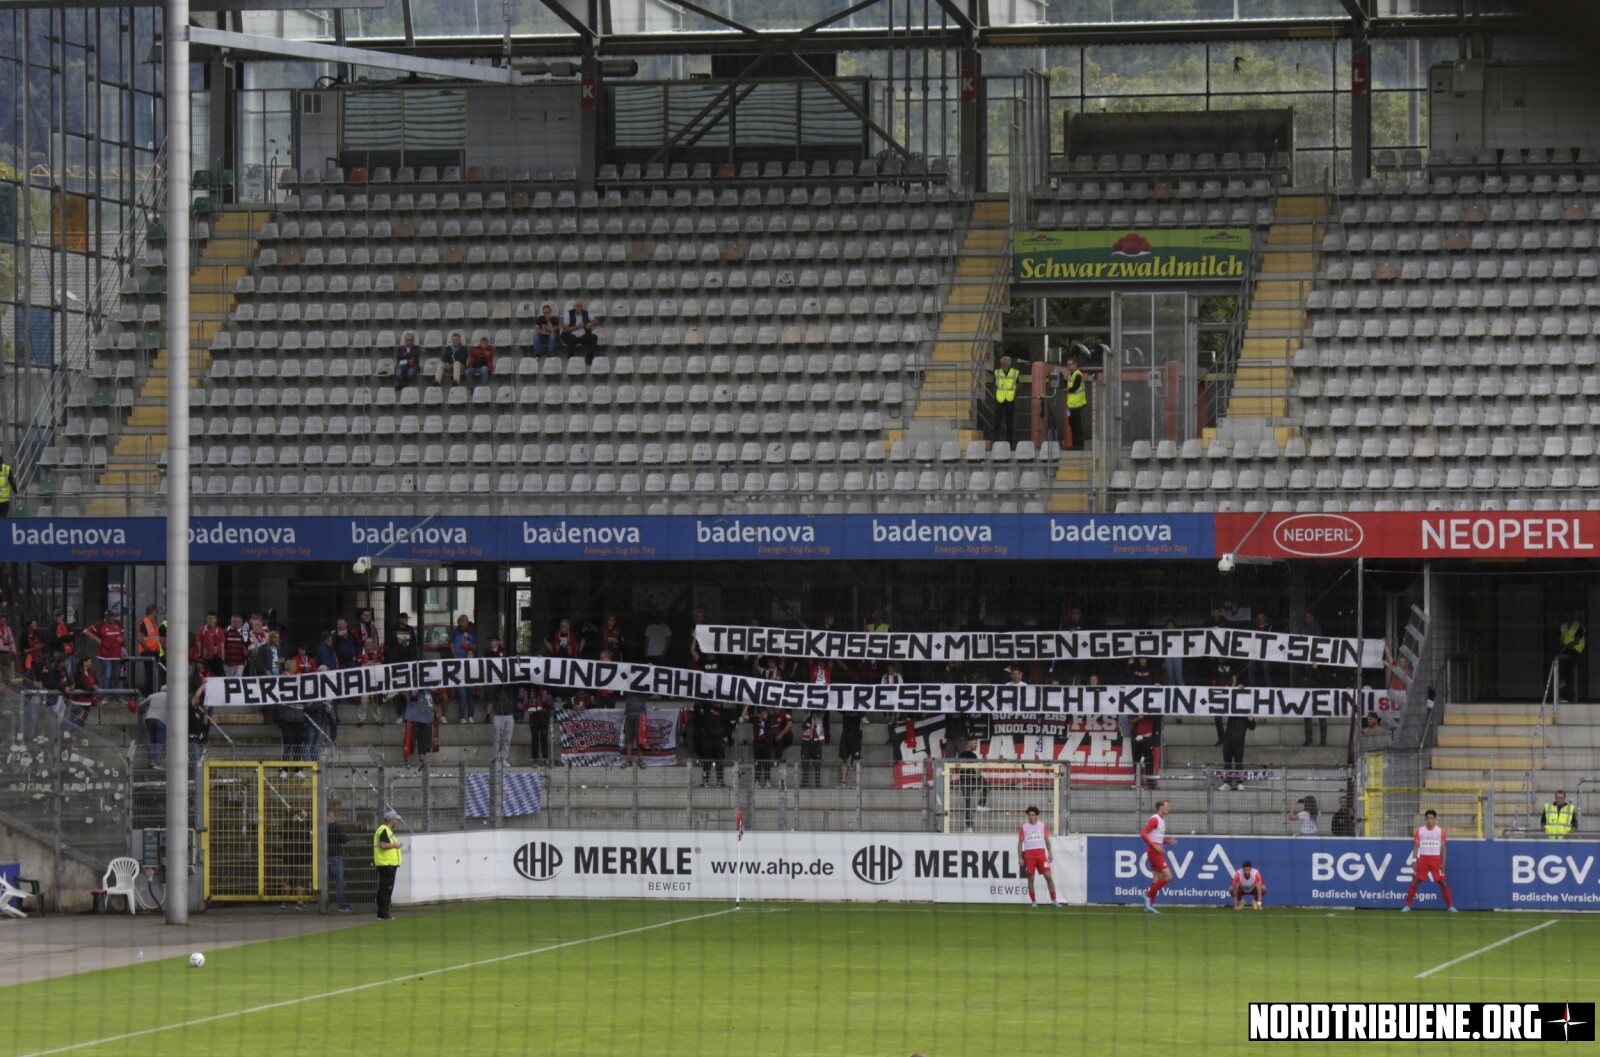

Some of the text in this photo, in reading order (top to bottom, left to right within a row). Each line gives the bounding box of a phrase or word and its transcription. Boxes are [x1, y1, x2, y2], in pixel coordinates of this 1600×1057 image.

[963, 78, 974, 91] K
[1354, 69, 1364, 82] L
[583, 85, 594, 98] K
[1020, 254, 1245, 278] Schwarzwaldmilch
[12, 523, 126, 545] badenova
[351, 521, 467, 544] badenova
[522, 521, 640, 543] badenova
[696, 520, 815, 542] badenova
[872, 520, 992, 542] badenova
[1050, 518, 1172, 542] badenova
[1421, 518, 1594, 550] NEOPERL
[443, 547, 455, 556] Tag
[470, 547, 482, 556] Tag
[616, 547, 628, 556] Tag
[643, 547, 656, 556] Tag
[790, 546, 803, 555] Tag
[818, 546, 830, 555] Tag
[967, 545, 979, 555] Tag
[994, 545, 1007, 555] Tag
[1146, 544, 1159, 554] Tag
[1174, 544, 1187, 554] Tag
[708, 626, 1364, 664] TAGESKASSEN MÜSSEN GEÖFFNET SEIN
[224, 658, 531, 704] PERSONALISIERUNG
[543, 658, 618, 687] UND
[629, 664, 942, 712] ZAHLUNGSSTRESS
[954, 684, 1108, 712] BRAUCHT
[1118, 687, 1197, 714] KEIN
[513, 841, 563, 882] AHP
[574, 846, 692, 875] MERKLE
[710, 857, 834, 880] www.ahp.de
[852, 844, 902, 885] AHP
[1312, 852, 1392, 882] BGV
[1512, 854, 1594, 884] BGV
[648, 882, 692, 891] BEWEGT
[1312, 889, 1437, 902] Badische Versicherngen
[1512, 892, 1600, 903] Badische Versich
